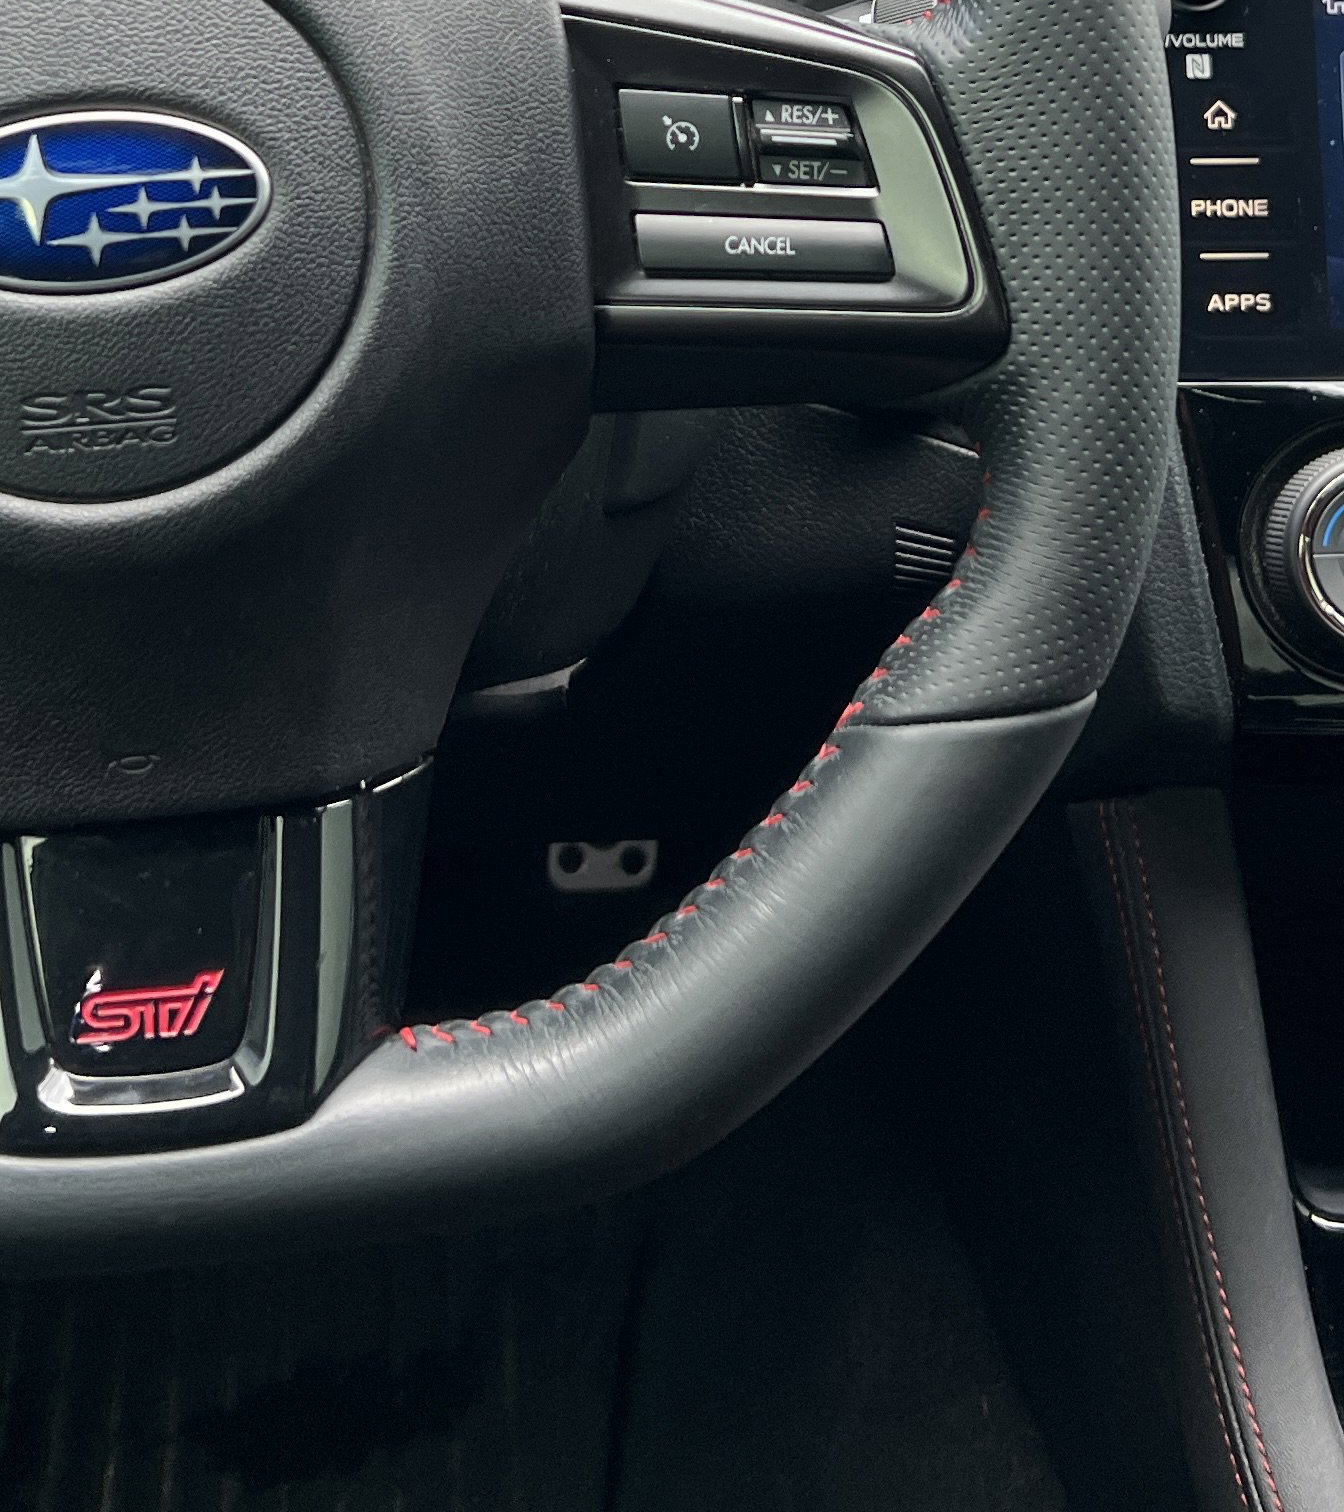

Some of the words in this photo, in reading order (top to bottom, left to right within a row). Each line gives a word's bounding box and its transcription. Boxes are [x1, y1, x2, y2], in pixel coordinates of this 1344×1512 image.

[1191, 199, 1269, 217] PHONE
[725, 236, 796, 256] CANCEL
[1208, 294, 1272, 312] APPS
[20, 387, 177, 426] SRS
